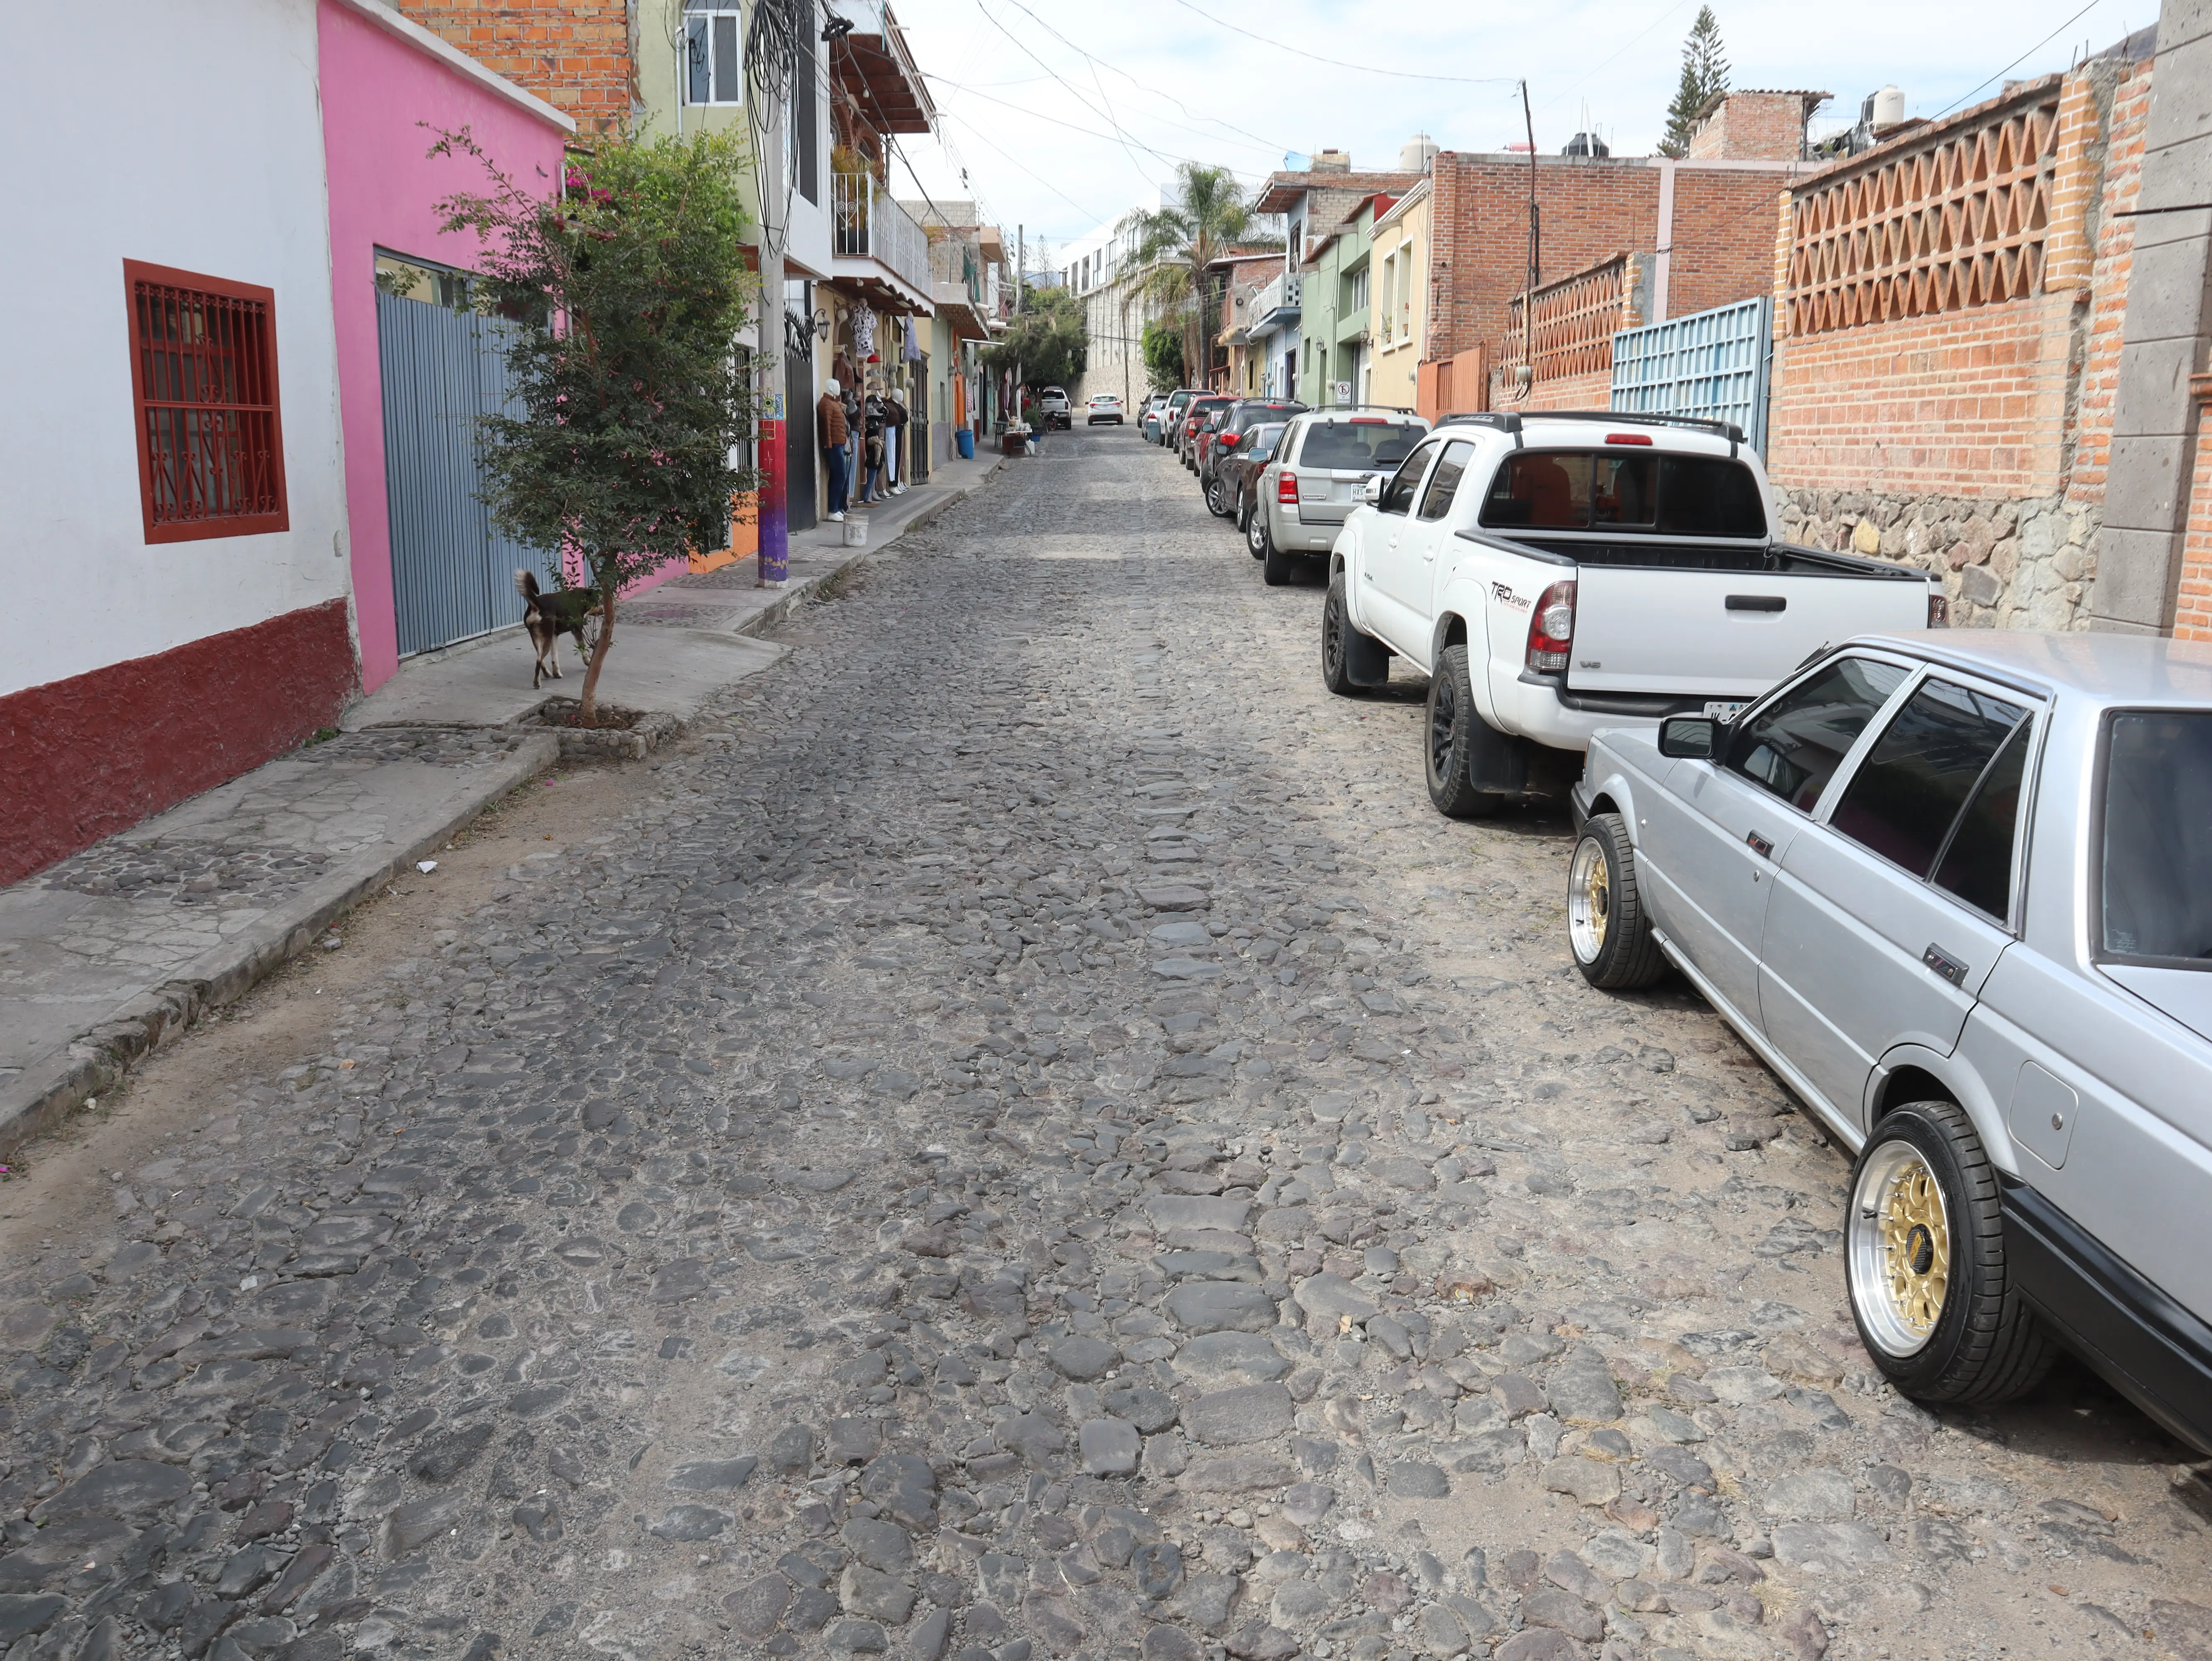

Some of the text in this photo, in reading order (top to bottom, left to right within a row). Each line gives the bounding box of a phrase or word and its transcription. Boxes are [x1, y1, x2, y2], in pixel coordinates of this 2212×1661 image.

[1491, 581, 1512, 604] TRD
[1511, 595, 1532, 609] SPORT
[1579, 660, 1601, 669] V6
